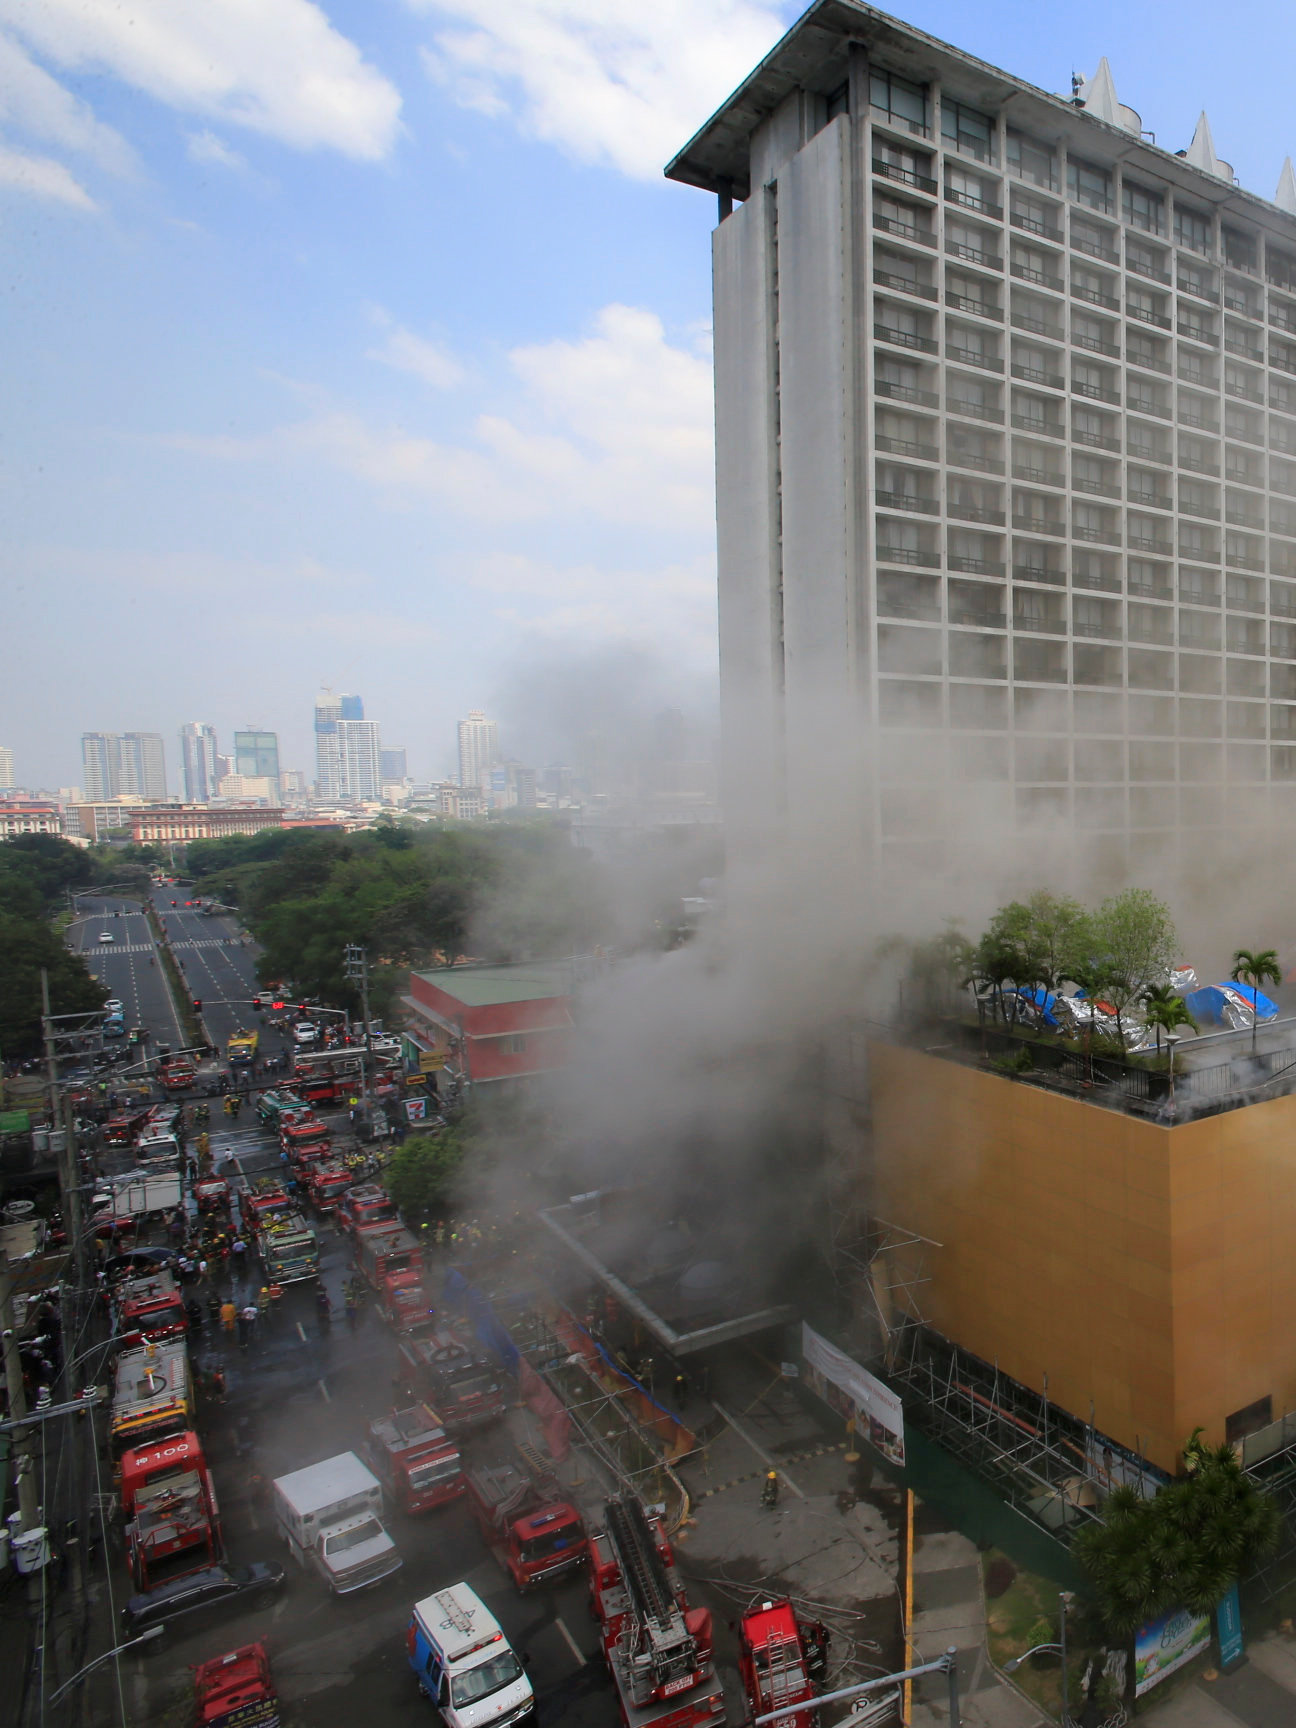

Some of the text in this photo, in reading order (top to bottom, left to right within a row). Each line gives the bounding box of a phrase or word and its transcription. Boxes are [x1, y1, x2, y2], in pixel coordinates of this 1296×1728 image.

[154, 1444, 189, 1458] 100
[665, 1675, 692, 1689] BACK OFF
